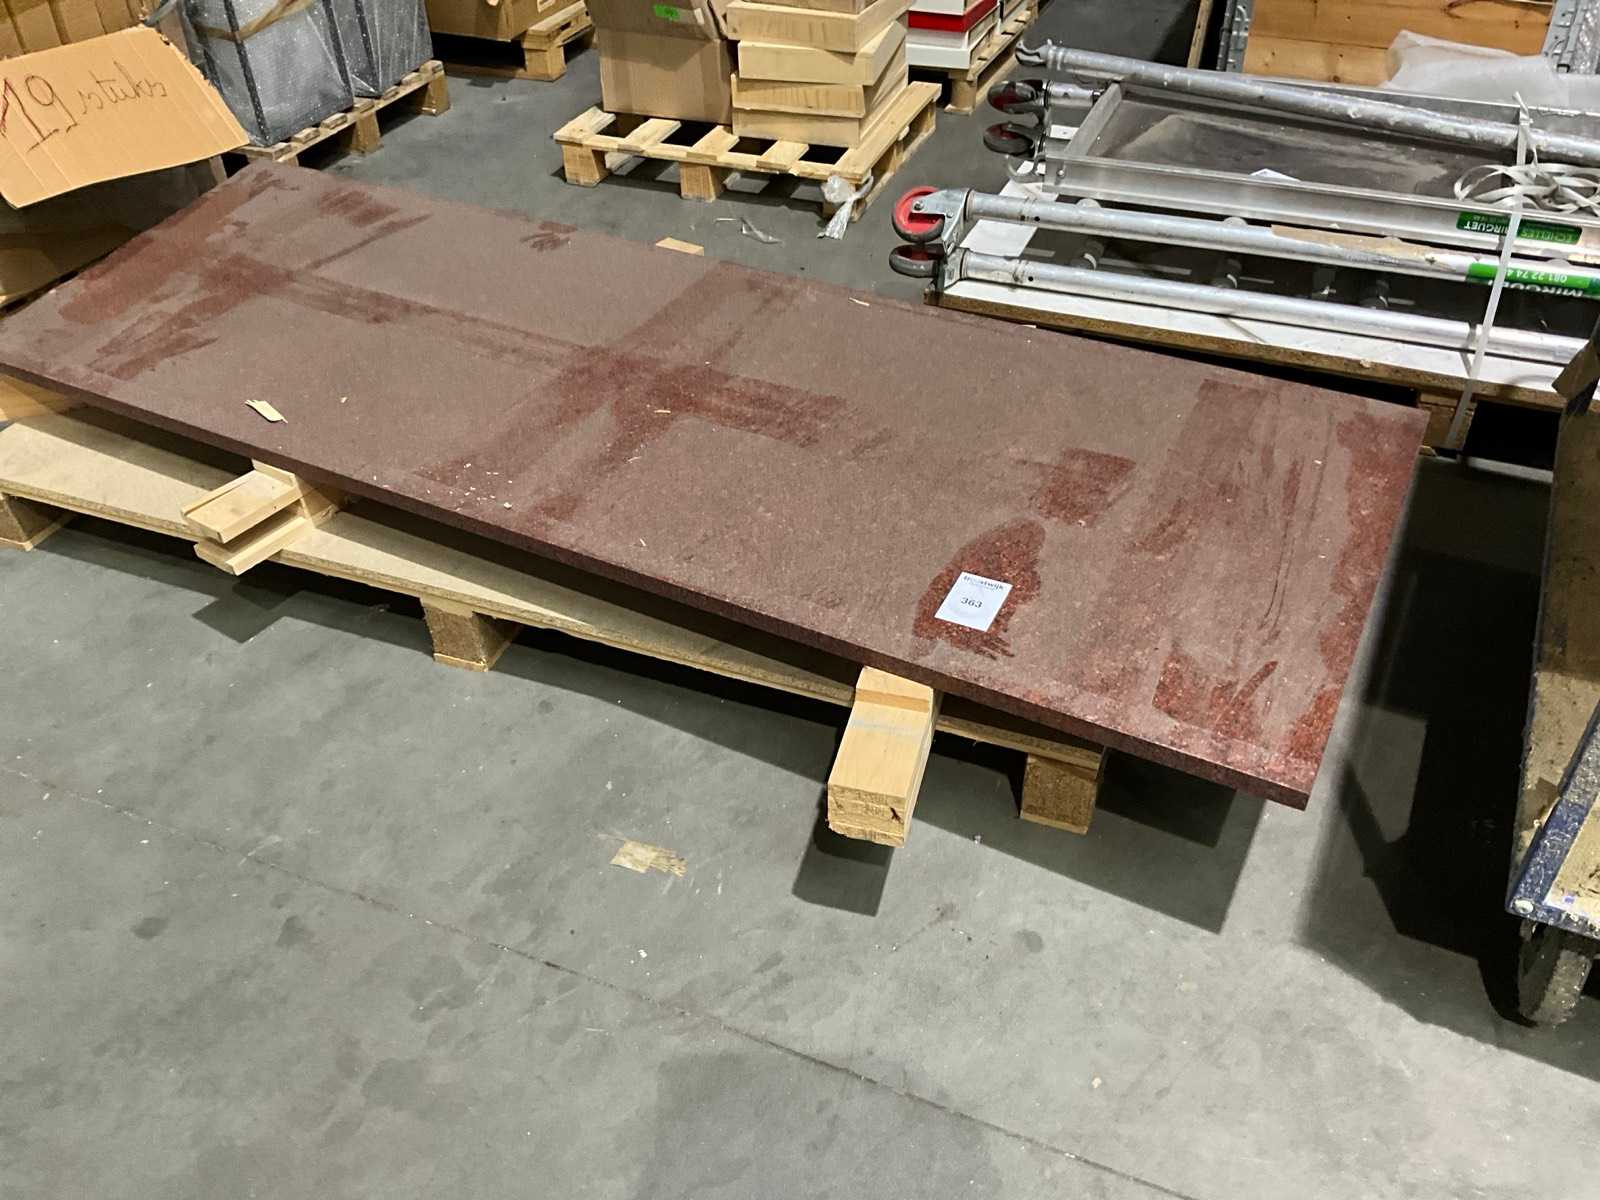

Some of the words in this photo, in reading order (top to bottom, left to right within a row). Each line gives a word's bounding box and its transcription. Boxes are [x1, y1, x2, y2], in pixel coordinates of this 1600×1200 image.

[0, 75, 78, 152] 19
[76, 61, 168, 115] stuks
[961, 597, 983, 608] 363
